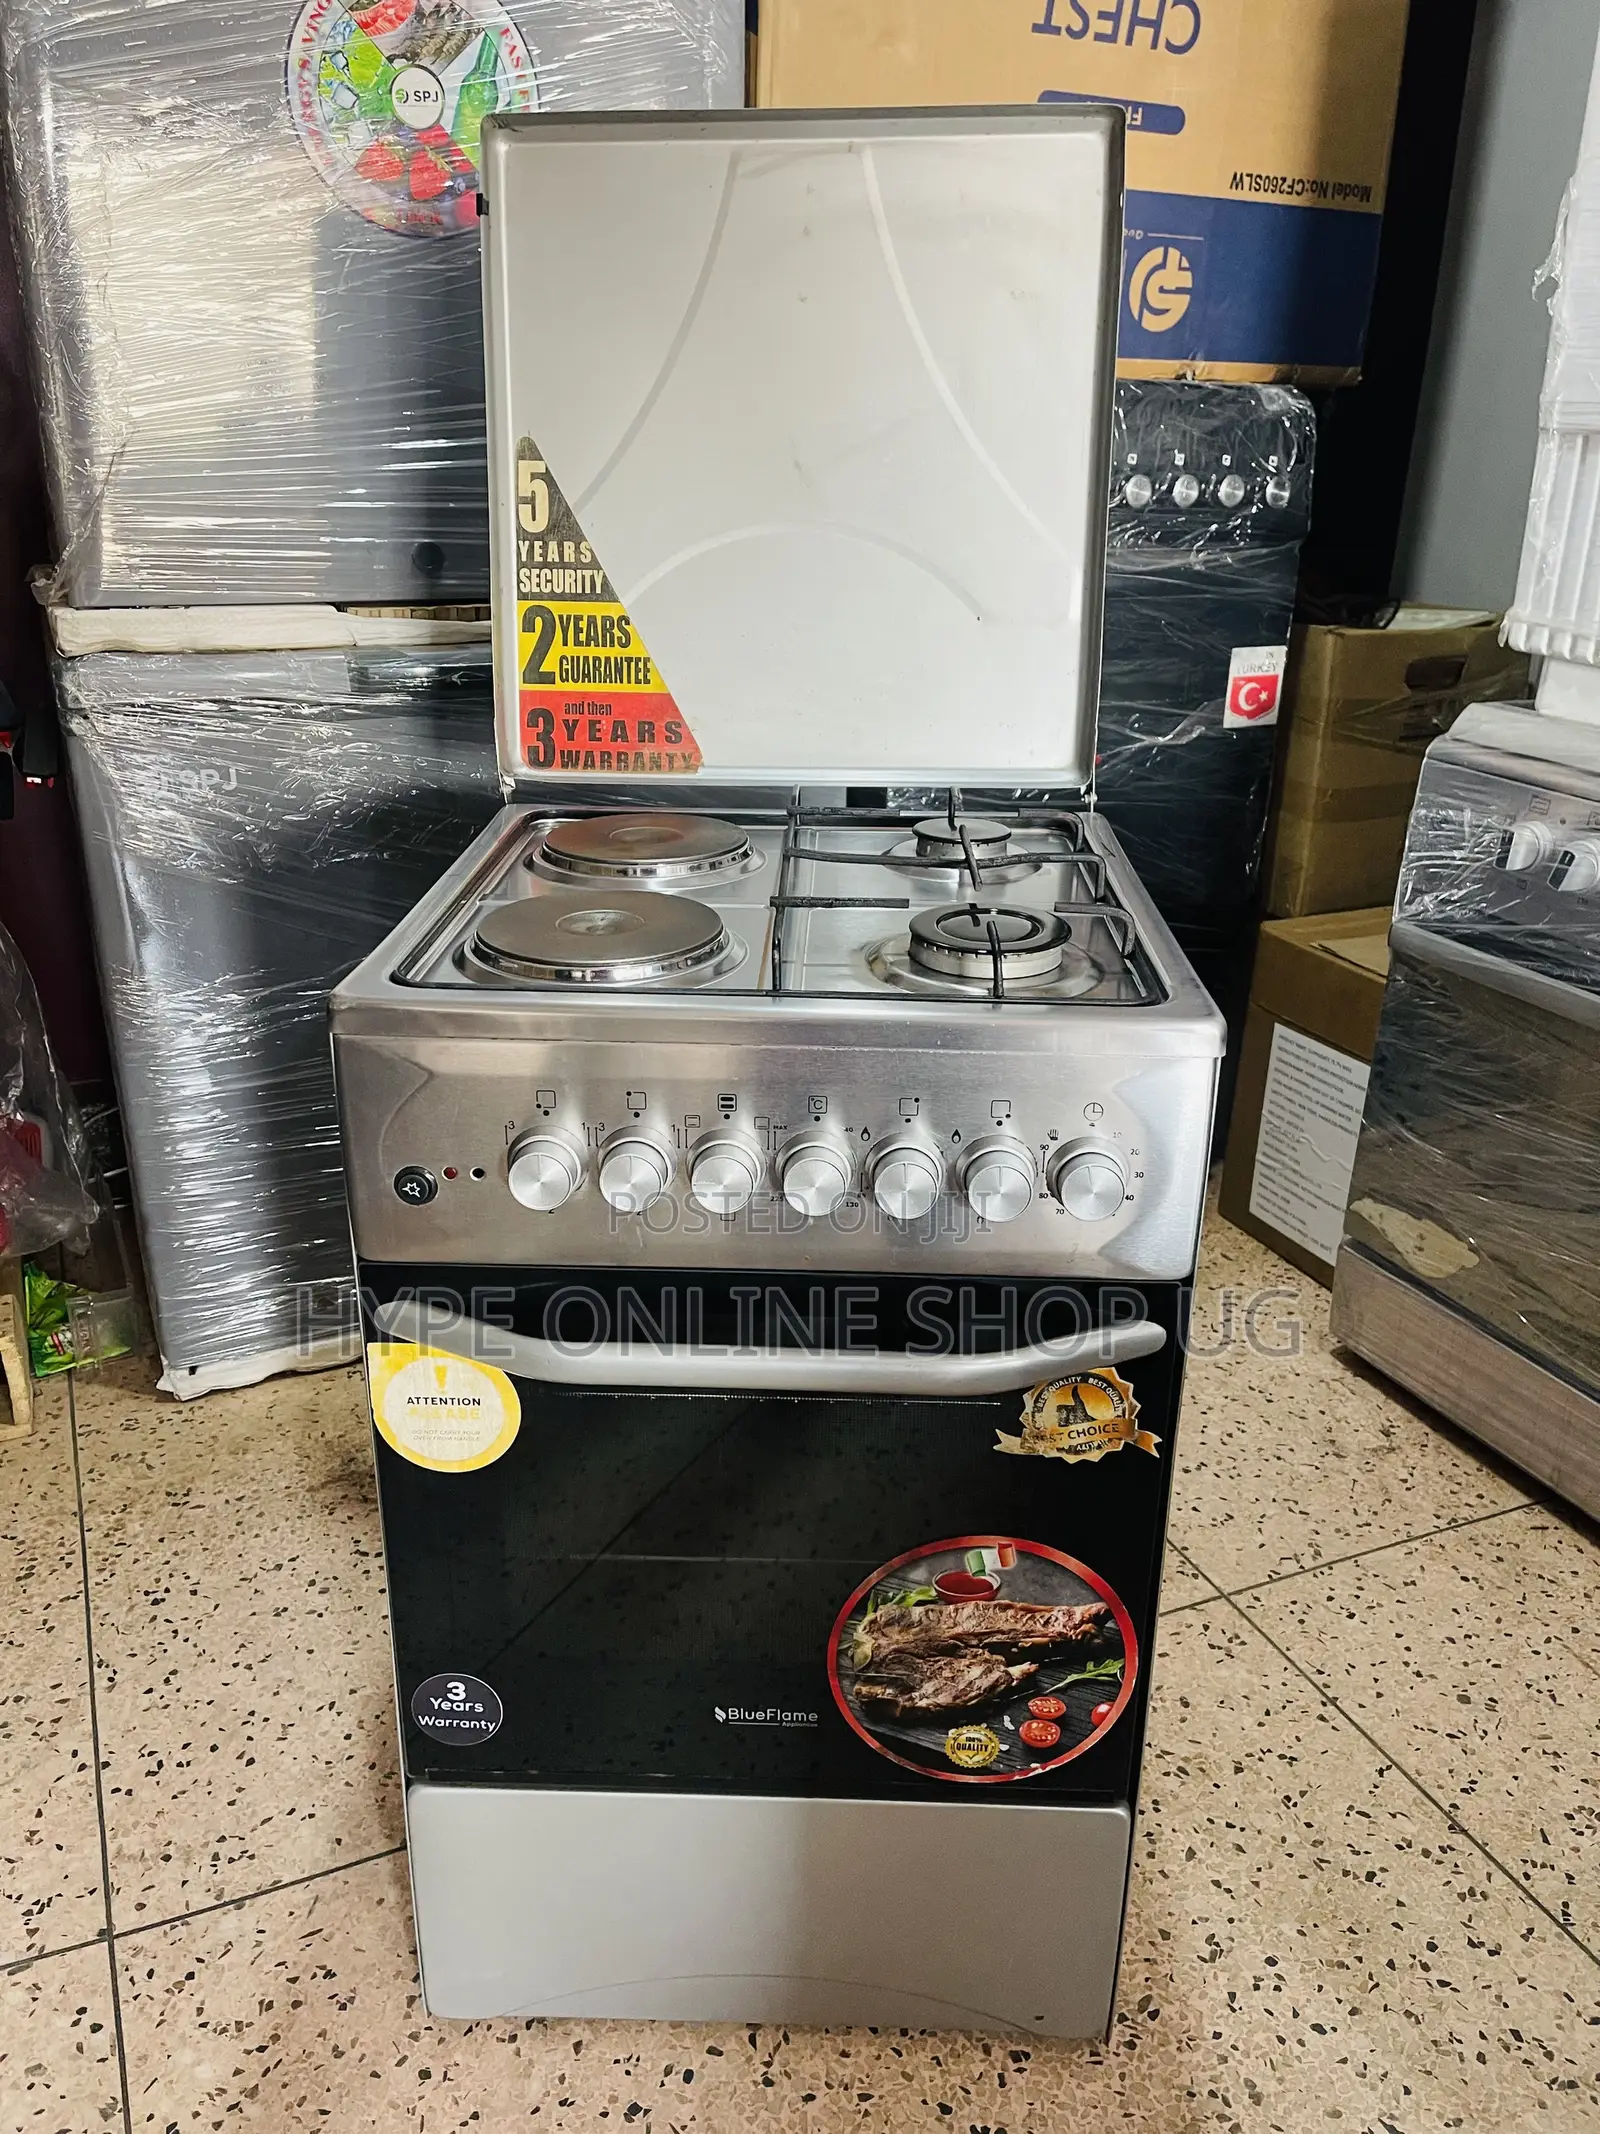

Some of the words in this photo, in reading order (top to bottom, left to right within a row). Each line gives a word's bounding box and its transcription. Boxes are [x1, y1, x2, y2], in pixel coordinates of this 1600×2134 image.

[1031, 0, 1201, 55] CHEST
[414, 90, 438, 102] SPJ
[1331, 184, 1373, 203] Model
[517, 459, 550, 534] 5
[518, 540, 592, 563] YEARS
[519, 567, 605, 594] SECURITY
[522, 605, 557, 685] 2
[557, 614, 632, 649] YEARS
[559, 655, 651, 685] GUARANTEE
[564, 701, 584, 715] and
[586, 702, 612, 716] then
[526, 707, 556, 770] 3
[562, 718, 683, 743] YEARS
[560, 749, 700, 772] WARRANTY
[1048, 1376, 1082, 1392] QUALITY
[1088, 1377, 1108, 1389] BEST
[407, 1396, 481, 1406] ATTENTION
[1067, 1424, 1119, 1439] CHOICE
[446, 1681, 466, 1701] 3
[429, 1697, 484, 1712] Years
[418, 1715, 496, 1732] Warranty
[728, 1707, 818, 1722] BlueFlame
[956, 1742, 989, 1752] QUALITY
